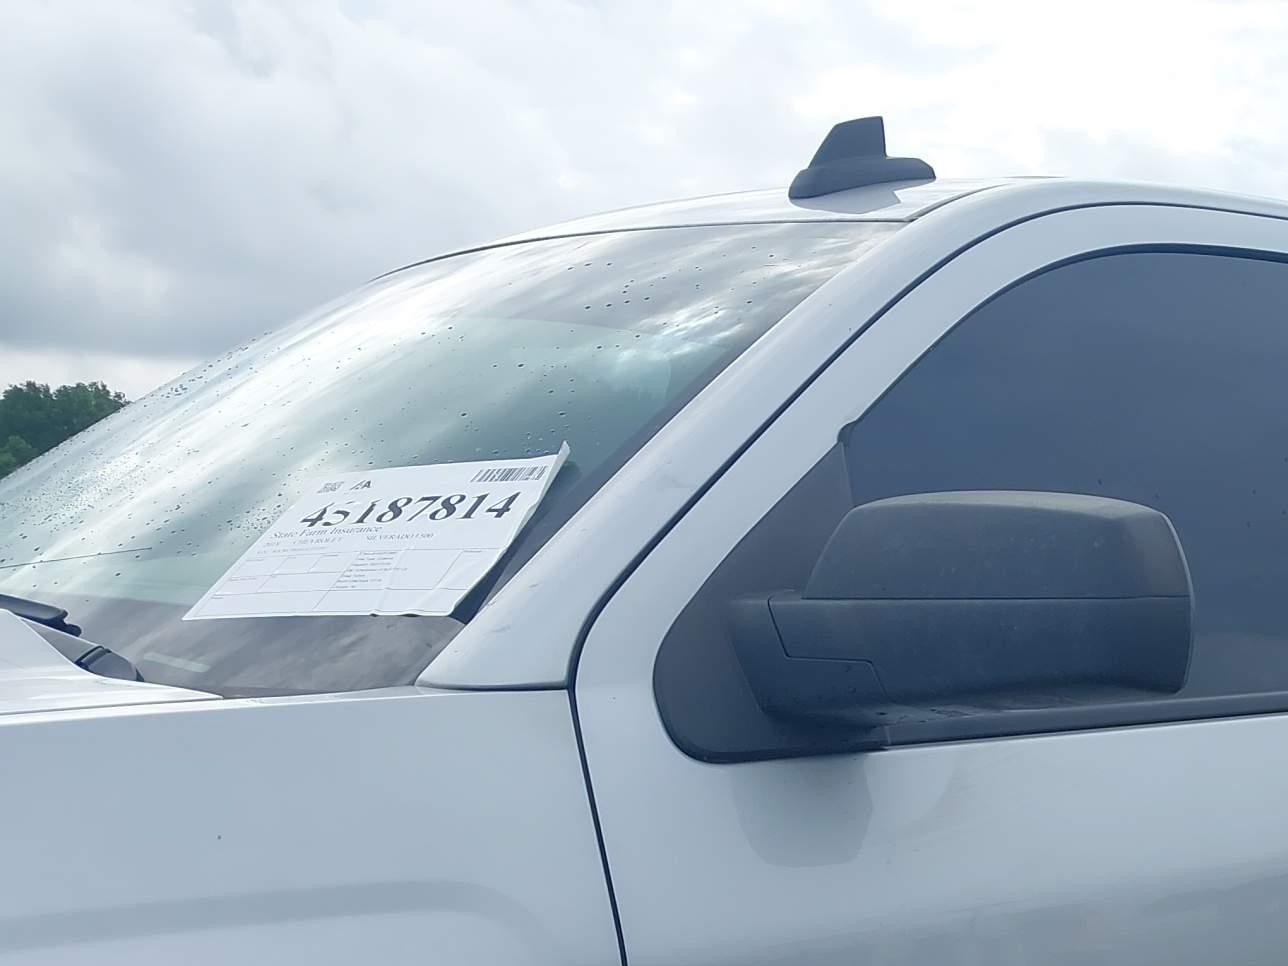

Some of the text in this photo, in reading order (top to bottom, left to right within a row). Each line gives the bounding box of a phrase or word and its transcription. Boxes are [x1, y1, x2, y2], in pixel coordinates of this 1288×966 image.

[300, 491, 522, 527] 45187814
[299, 528, 328, 537] Farm
[329, 526, 382, 536] Insurance
